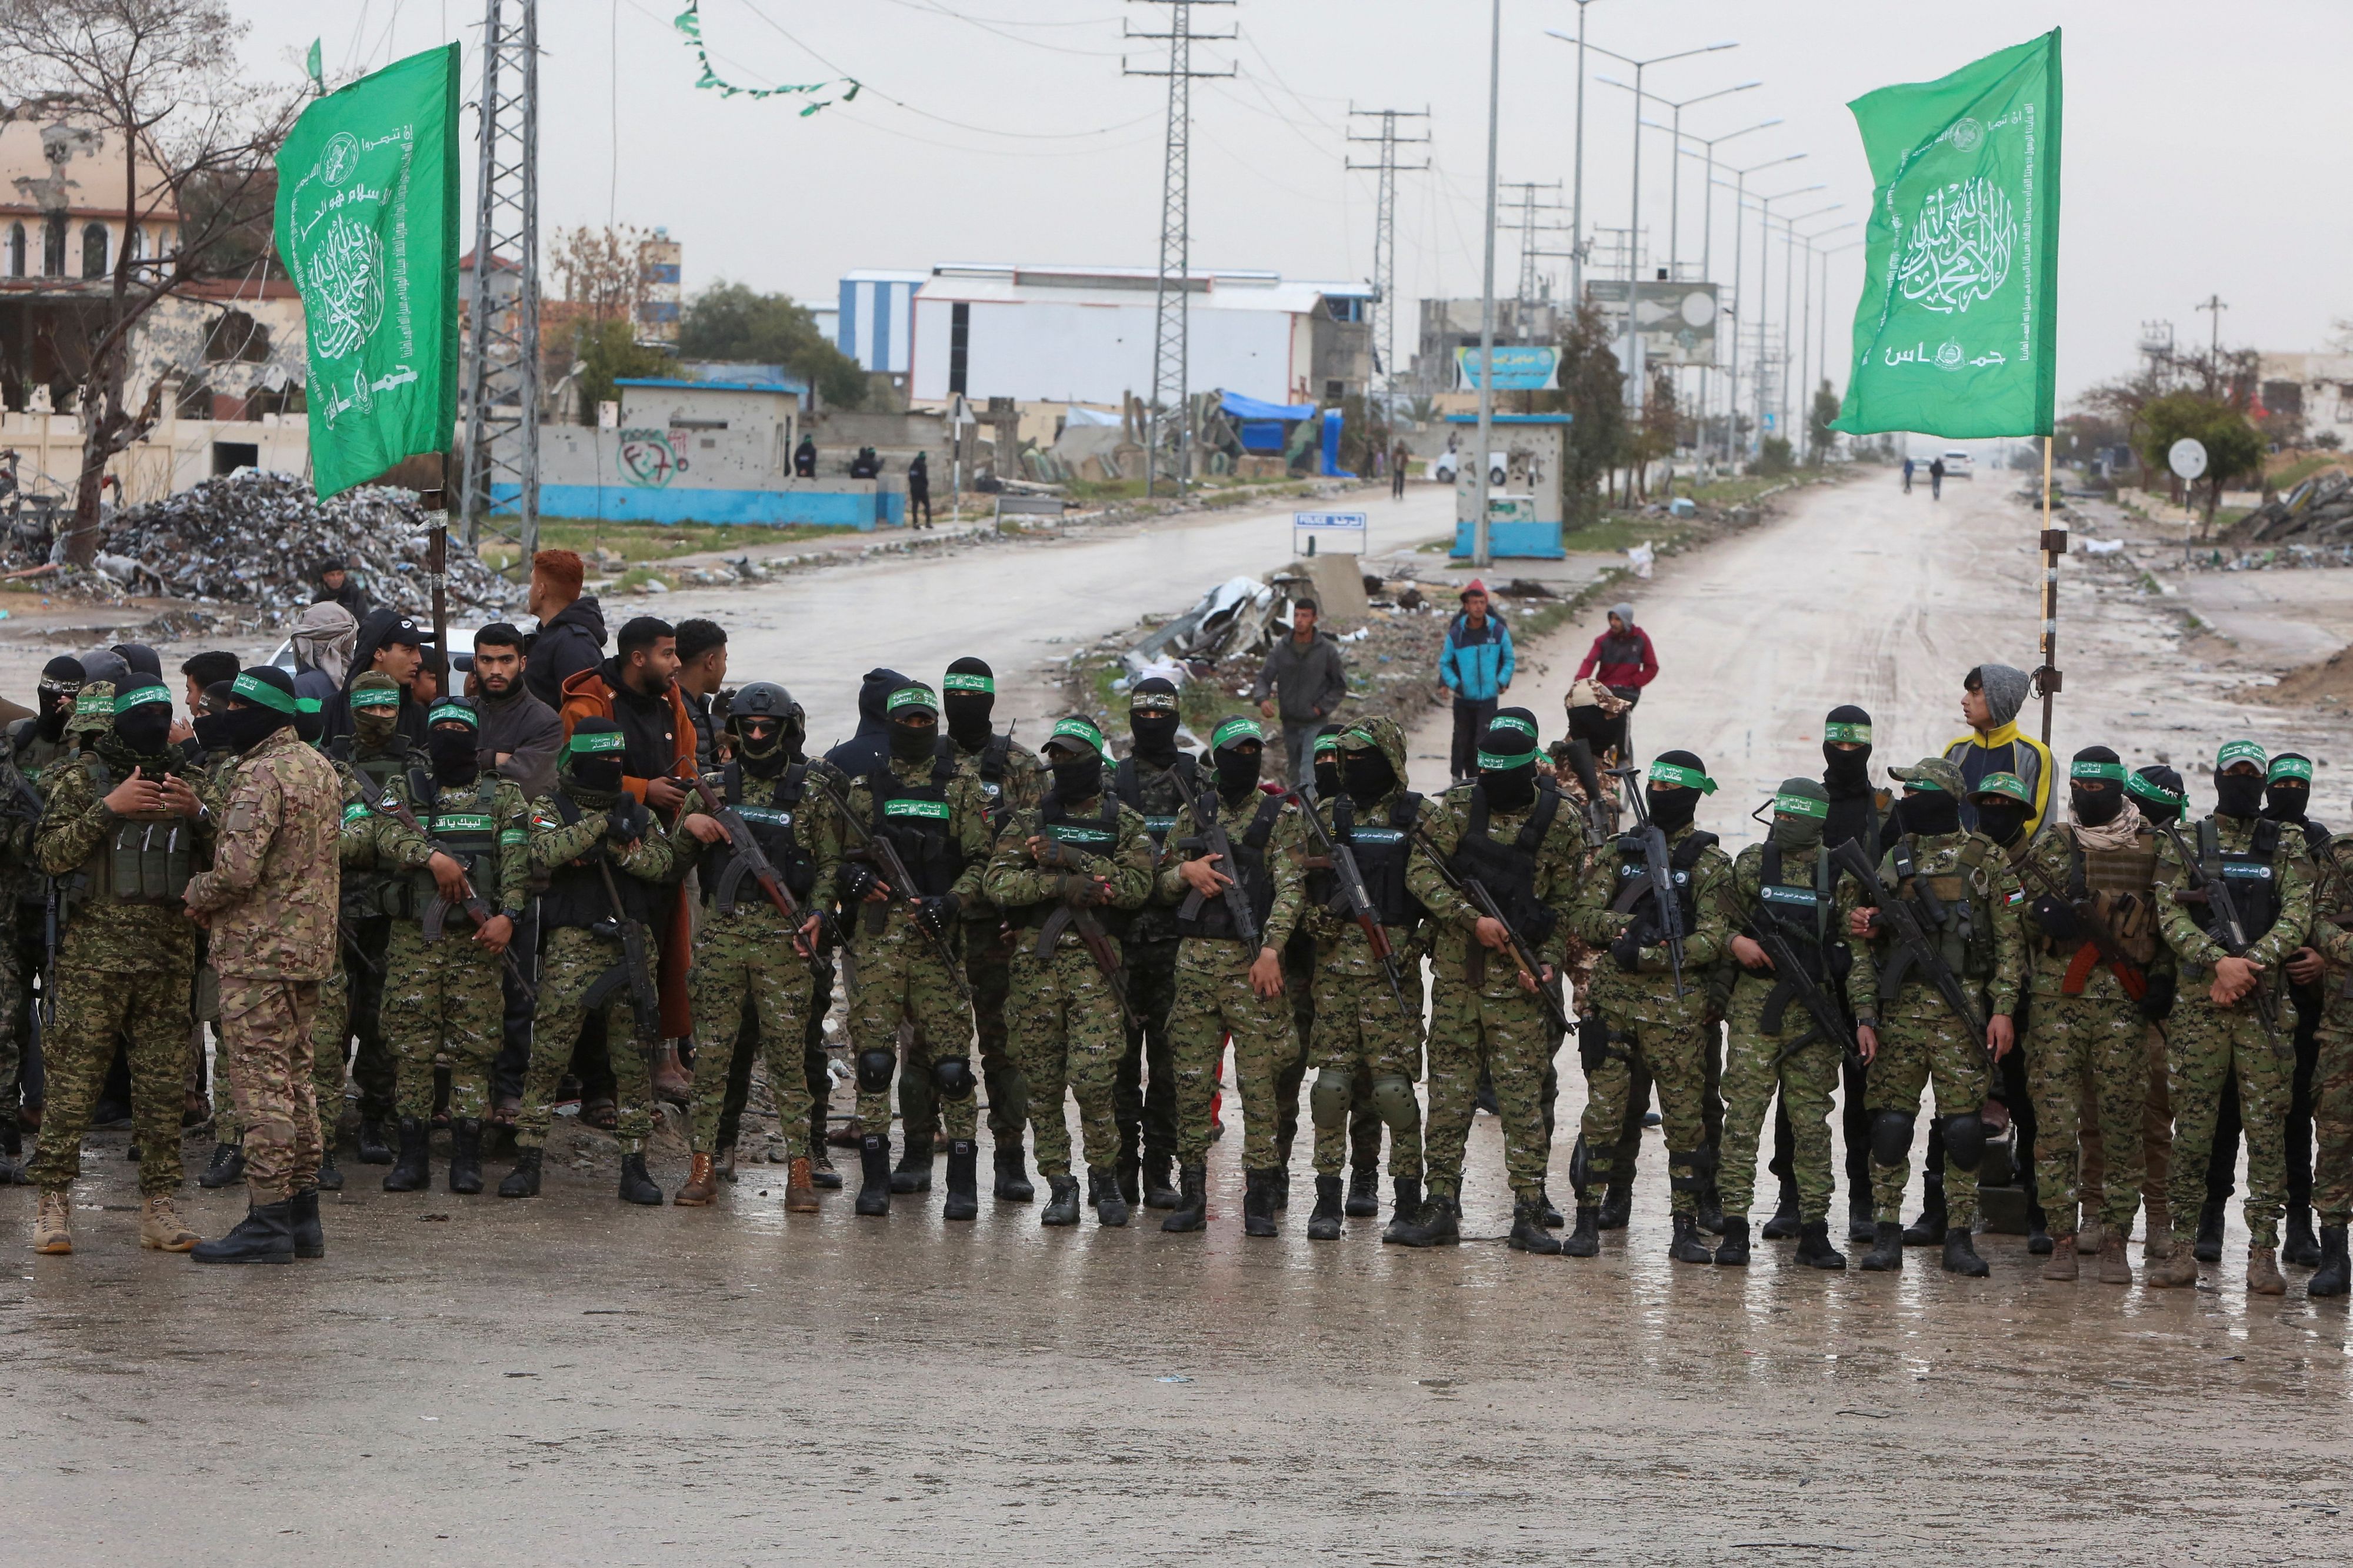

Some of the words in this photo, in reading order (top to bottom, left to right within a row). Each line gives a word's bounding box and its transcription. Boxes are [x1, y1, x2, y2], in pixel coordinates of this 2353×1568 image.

[2024, 104, 2034, 114] الله
[2024, 135, 2034, 155] الرسول
[329, 190, 345, 211] هو
[1885, 341, 2006, 367] حماس
[592, 742, 610, 750] القسام
[1664, 771, 1682, 781] كتائب
[1789, 803, 1810, 812] كتائب
[447, 819, 455, 828] يا
[457, 818, 481, 828] لبيك
